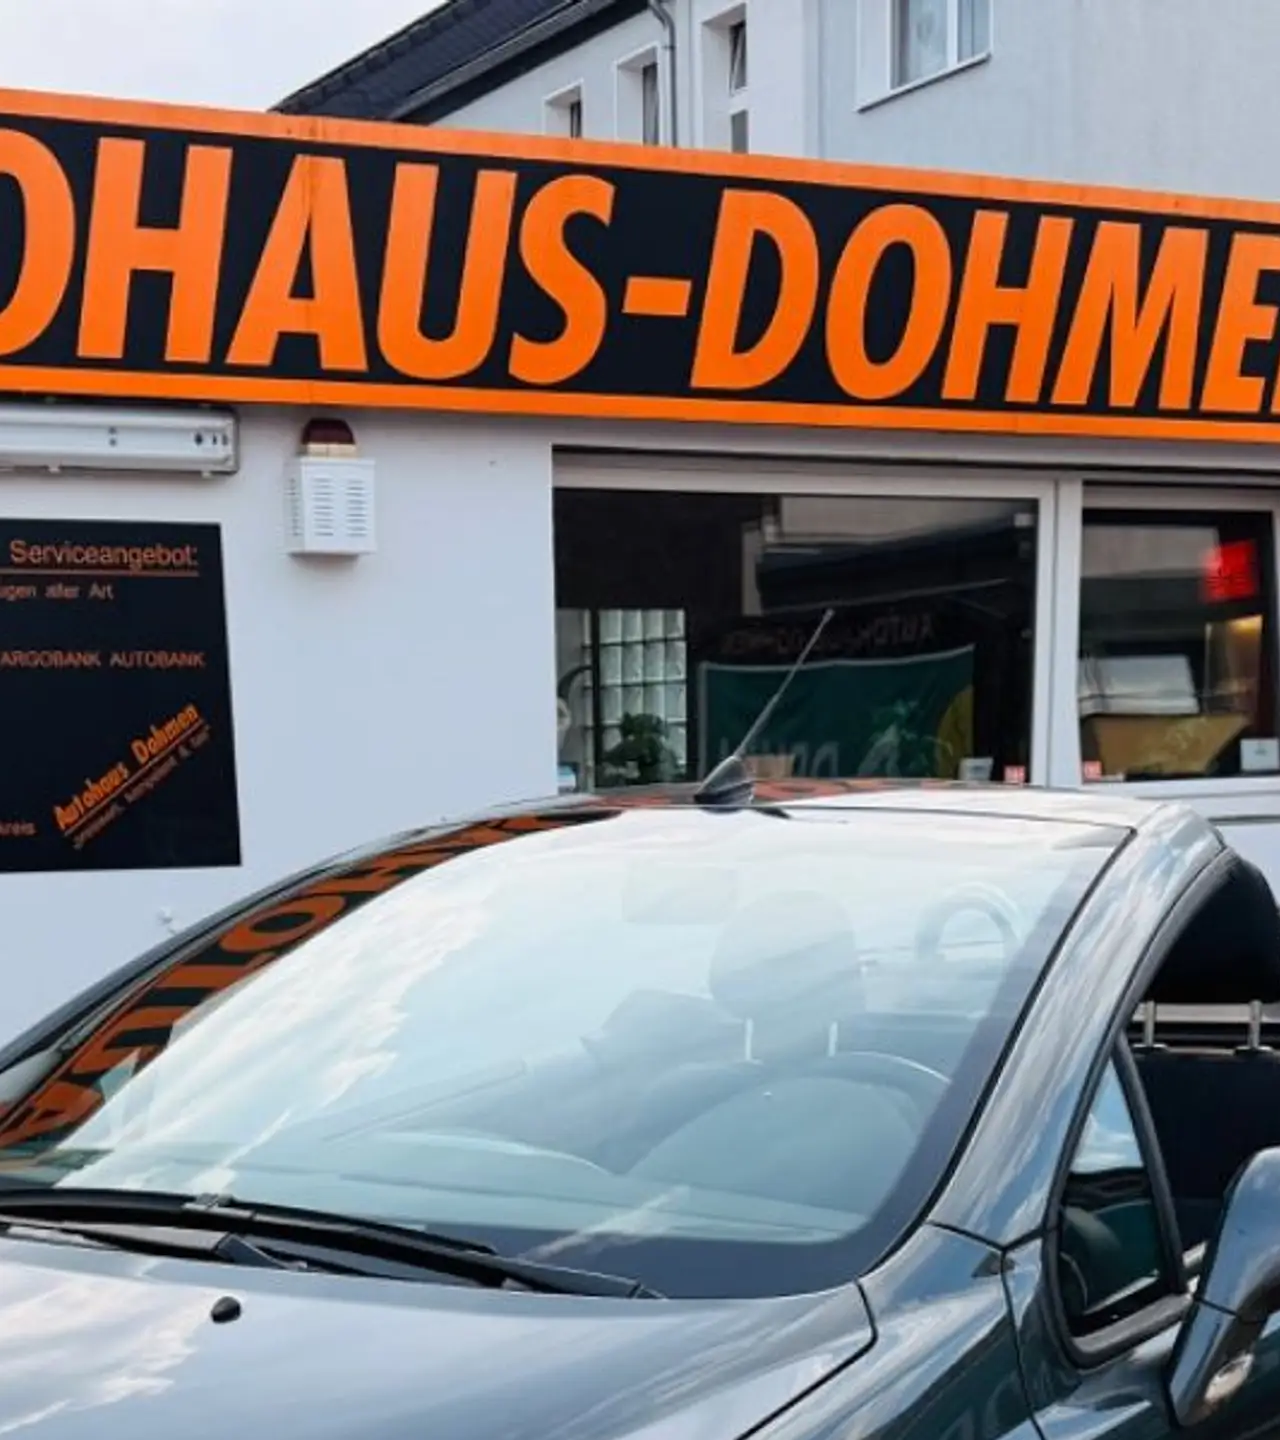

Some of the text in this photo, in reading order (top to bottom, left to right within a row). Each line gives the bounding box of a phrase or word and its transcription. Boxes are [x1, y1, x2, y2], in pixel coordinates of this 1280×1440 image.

[9, 539, 199, 573] Serviceangebot:
[45, 581, 80, 599] aller
[88, 582, 114, 600] Art
[109, 651, 206, 668] AUTOBANK
[53, 761, 130, 831] Autohaus
[130, 703, 200, 765] Dohmen
